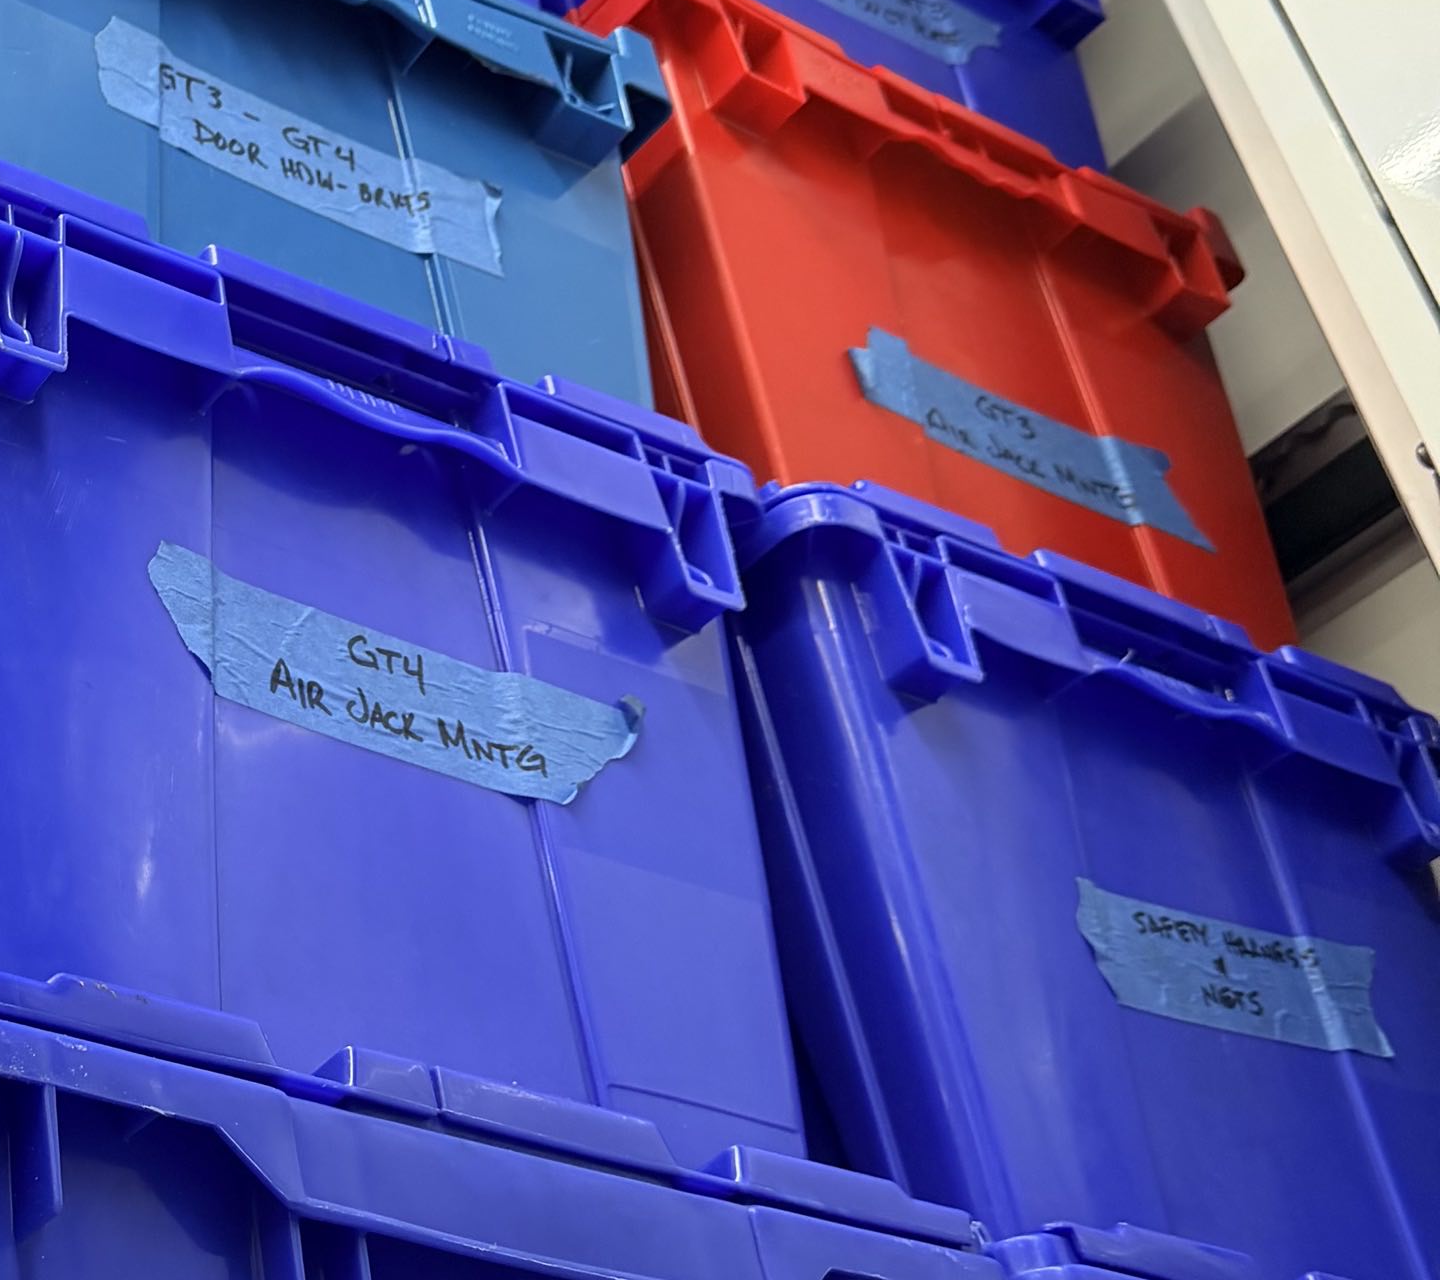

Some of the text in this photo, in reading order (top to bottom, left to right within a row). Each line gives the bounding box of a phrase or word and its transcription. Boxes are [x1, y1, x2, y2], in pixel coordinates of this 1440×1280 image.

[159, 63, 223, 110] GT3
[282, 126, 356, 172] GT4
[192, 118, 269, 169] DOOR
[975, 395, 1036, 440] GT3
[346, 635, 426, 695] GT4
[269, 658, 549, 778] AIR JACK MNTG
[1200, 982, 1264, 1017] NETS
